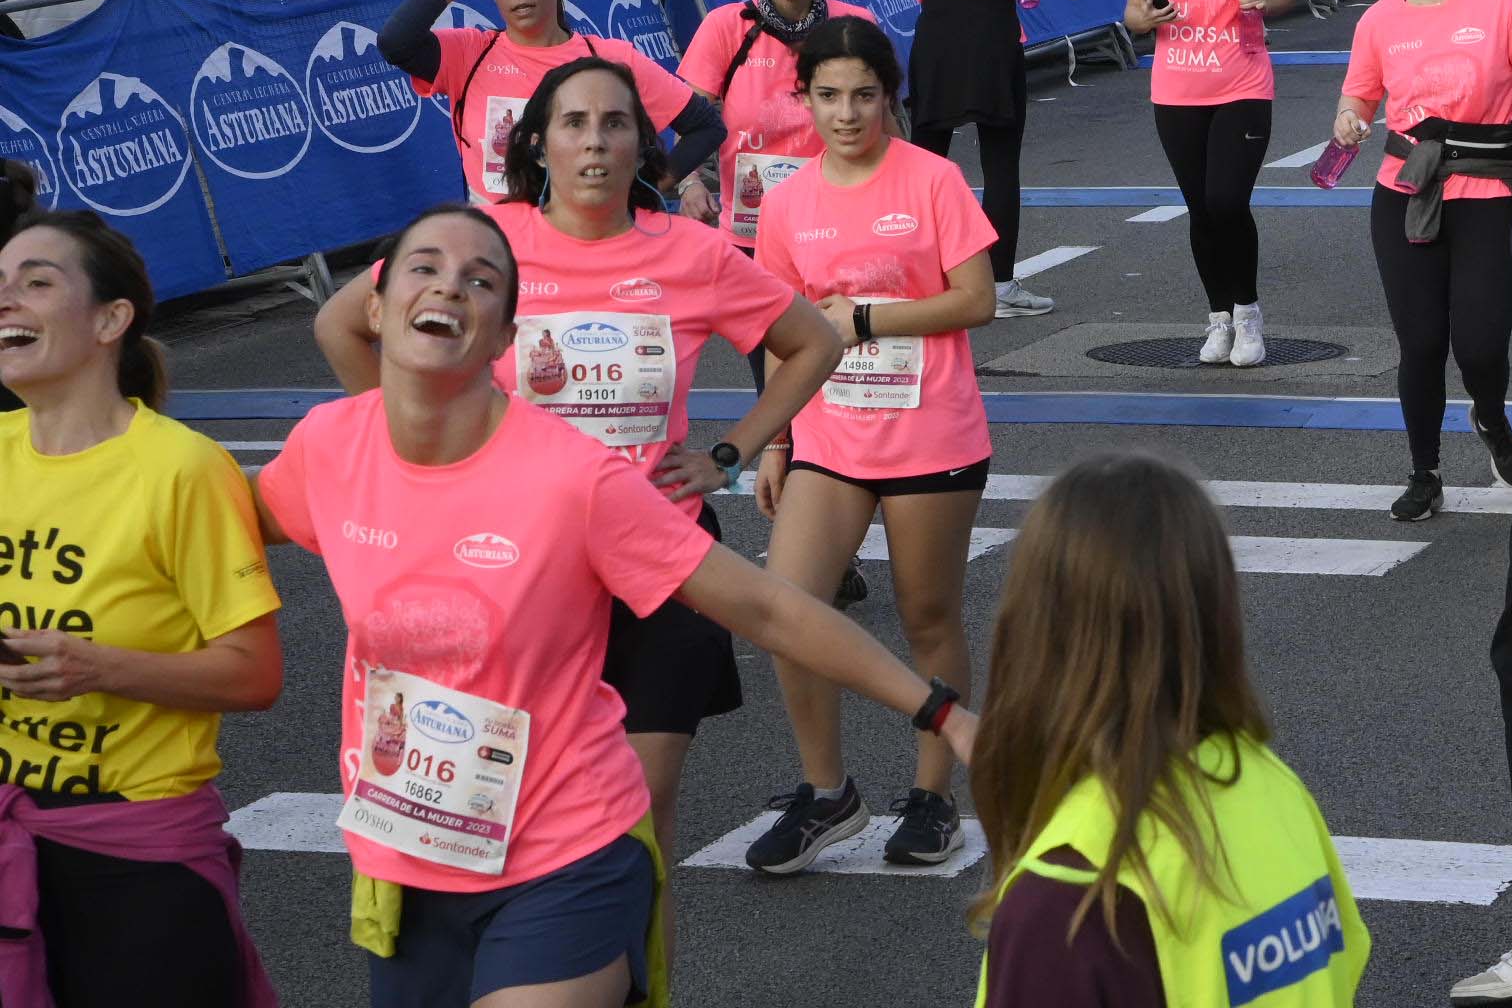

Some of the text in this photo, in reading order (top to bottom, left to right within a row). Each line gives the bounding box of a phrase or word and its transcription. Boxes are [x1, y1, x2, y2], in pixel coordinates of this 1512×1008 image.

[1169, 26, 1240, 43] DORSAL
[1167, 47, 1221, 66] SUMA
[316, 76, 417, 128] ASTURIANA
[202, 98, 307, 152] ASTURIANA
[794, 227, 838, 242] OYSHO
[519, 280, 560, 296] SHO
[567, 331, 625, 346] ASTURIANA
[633, 329, 662, 338] SUMA
[570, 362, 624, 383] 016
[843, 361, 875, 371] 14988
[855, 375, 865, 383] LA
[866, 374, 891, 383] MUJER
[576, 388, 618, 401] 19101
[580, 406, 593, 416] DE
[594, 406, 607, 416] LA
[608, 406, 636, 415] MUJER
[617, 424, 661, 435] Santander
[459, 543, 515, 562] ASTURIANA
[413, 709, 469, 740] ASTURIANA
[482, 724, 518, 741] SUMA
[406, 747, 457, 784] 016
[404, 779, 444, 805] 16862
[366, 787, 493, 835] CARRERA DE LA MUJER 2023
[354, 807, 394, 834] OYSHO
[431, 836, 492, 861] Santander
